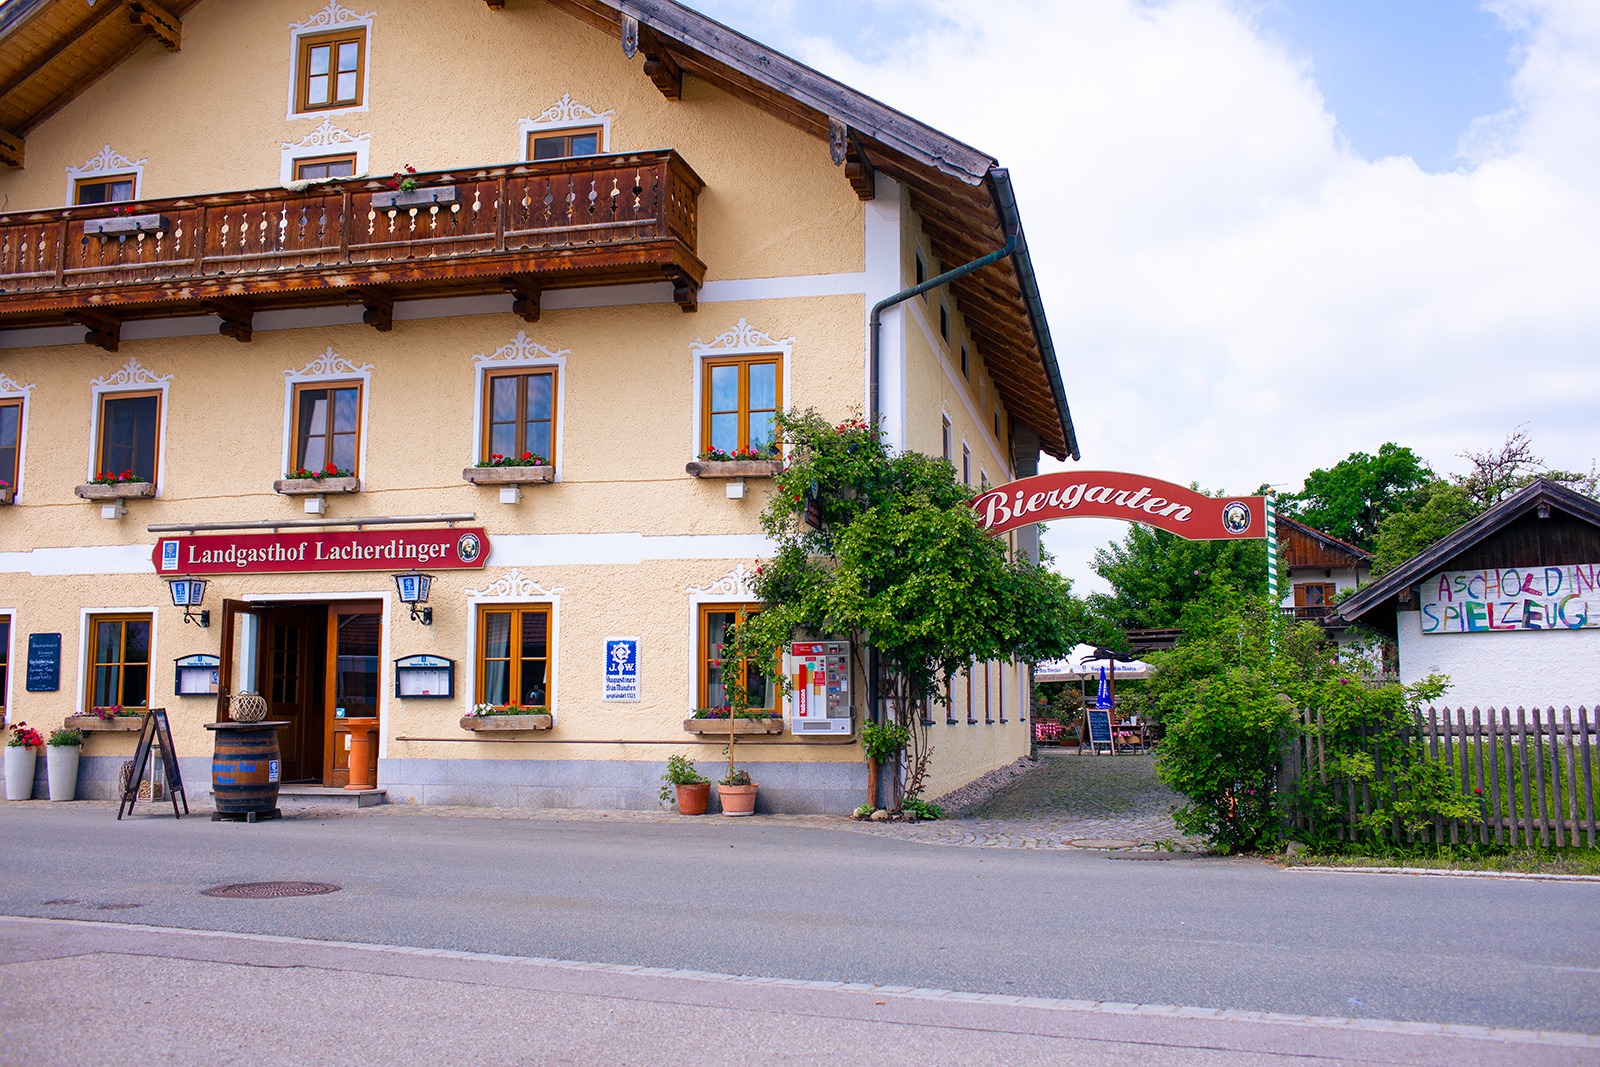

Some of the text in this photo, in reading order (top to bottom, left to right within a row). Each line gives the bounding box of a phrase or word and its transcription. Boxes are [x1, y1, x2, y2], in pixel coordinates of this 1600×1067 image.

[971, 482, 1192, 530] Biergarten
[188, 539, 451, 568] Landgasthof Lacherdinger
